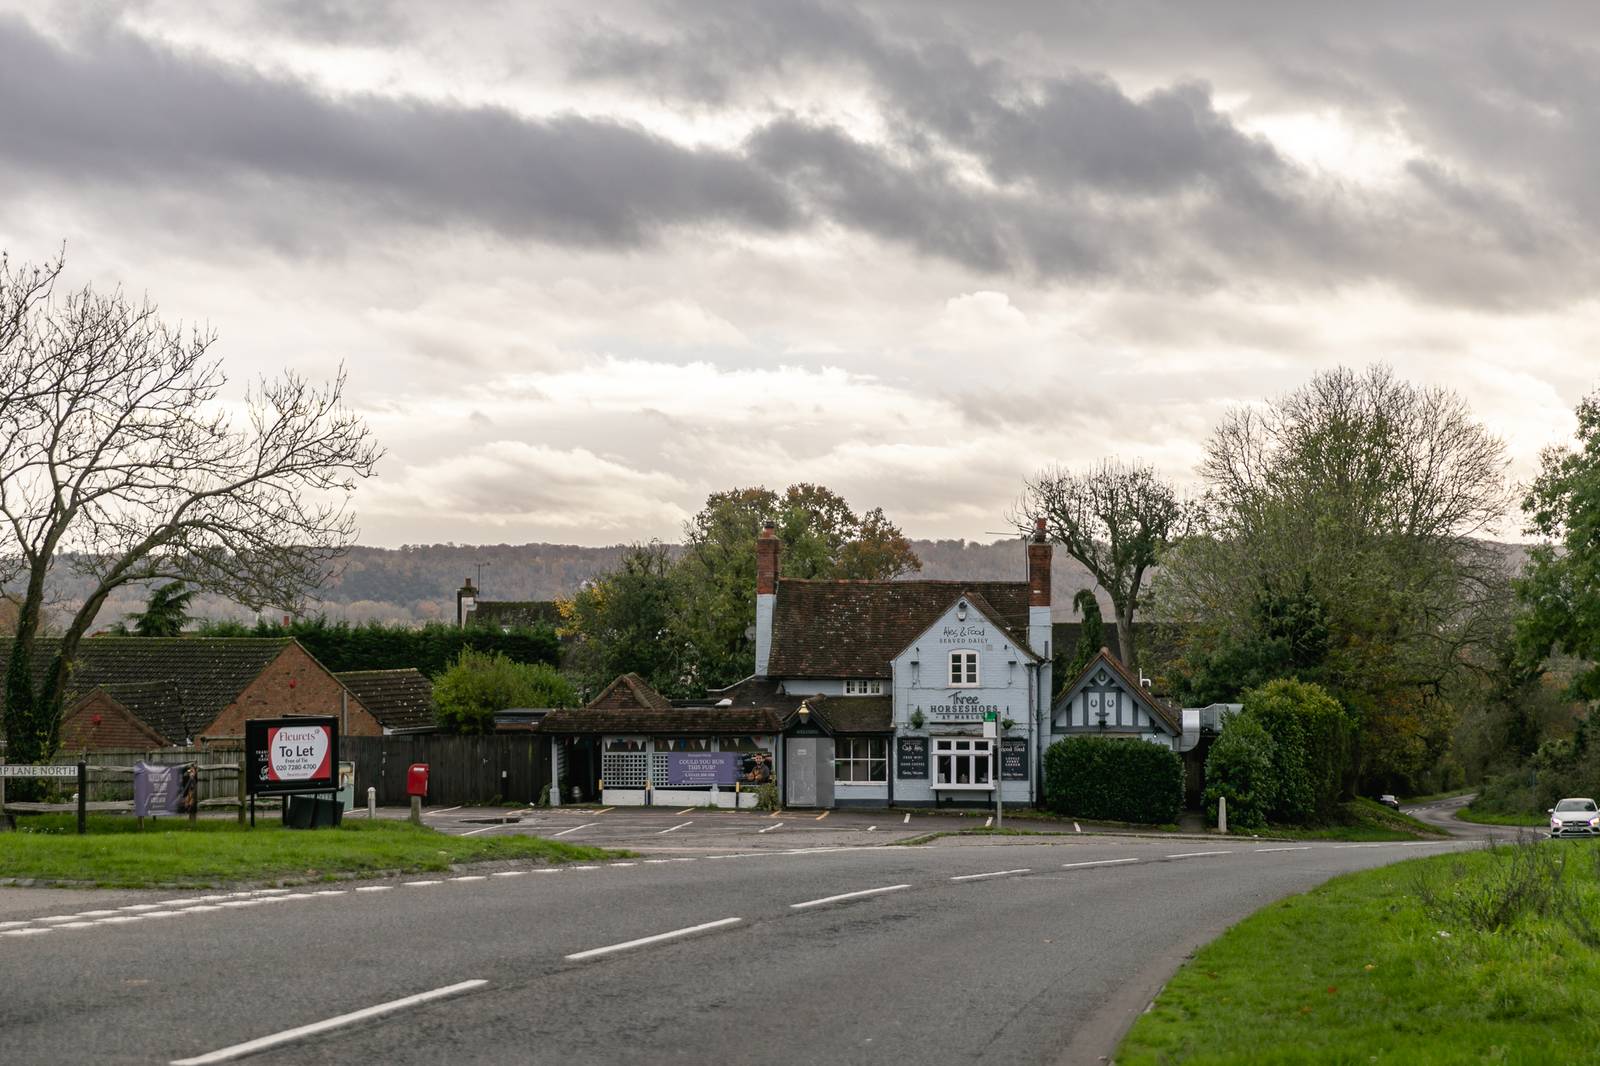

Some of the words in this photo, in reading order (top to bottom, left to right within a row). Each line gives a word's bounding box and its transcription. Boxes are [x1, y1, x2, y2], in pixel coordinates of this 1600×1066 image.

[959, 626, 967, 637] &
[967, 626, 985, 637] Food
[948, 691, 980, 705] Three
[930, 705, 998, 713] HORSESHOES
[279, 731, 316, 742] Fleurets
[279, 745, 293, 758] To
[296, 745, 314, 757] Let
[12, 766, 37, 775] LANE
[40, 766, 77, 775] NORTH
